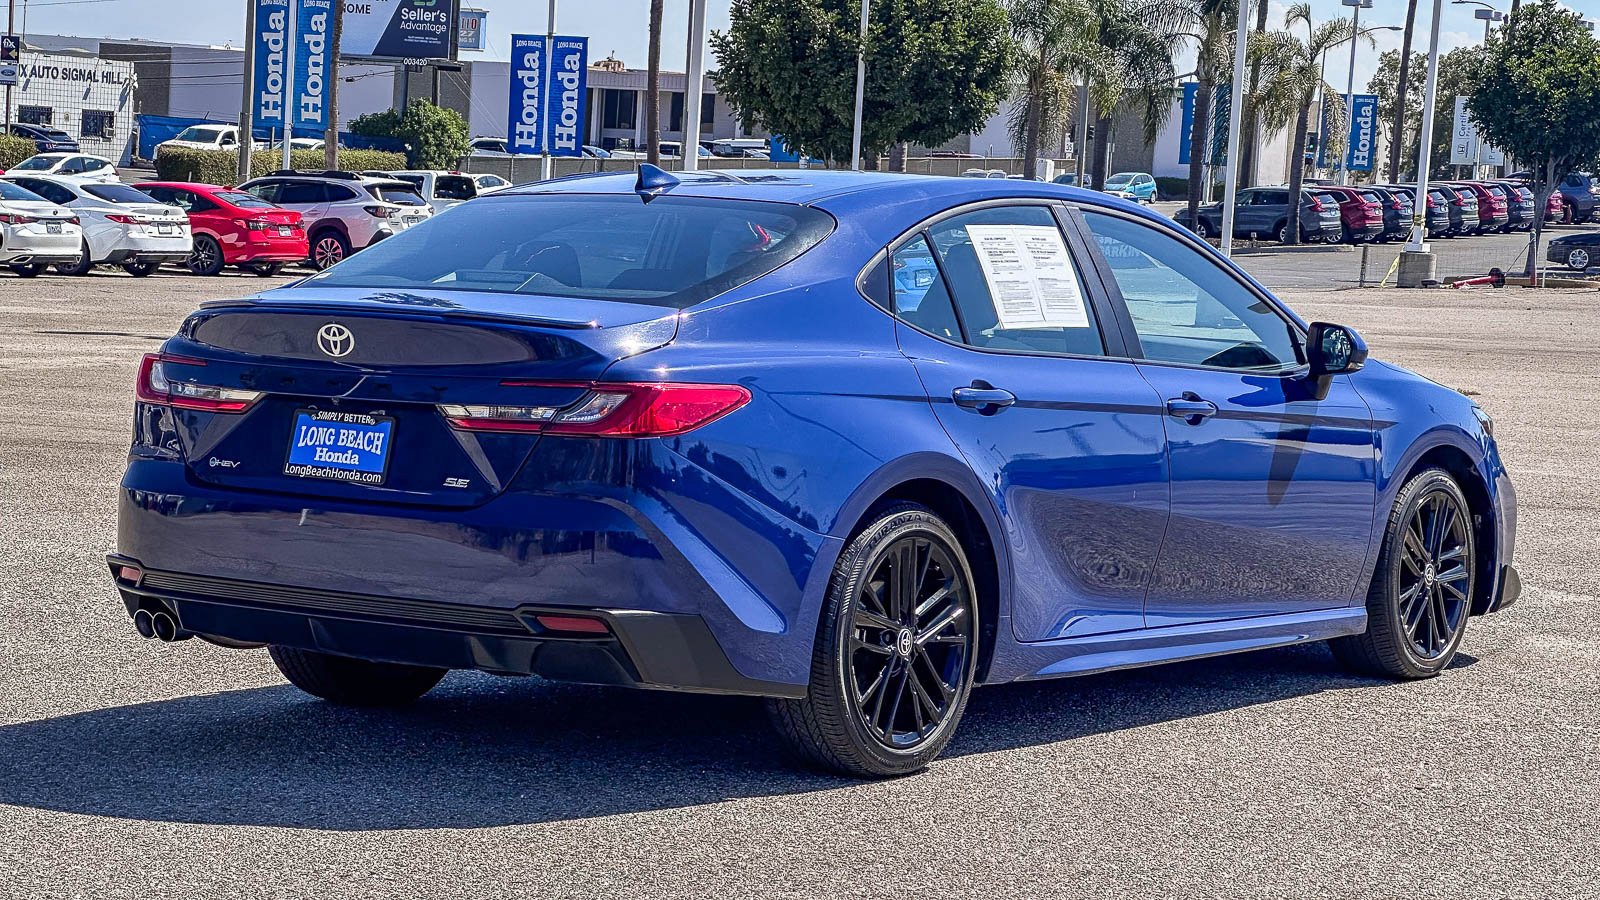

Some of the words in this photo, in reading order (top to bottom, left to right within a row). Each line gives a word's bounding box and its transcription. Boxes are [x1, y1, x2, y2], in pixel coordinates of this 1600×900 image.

[400, 20, 447, 34] Advantage
[29, 65, 59, 80] AUTO
[61, 67, 99, 82] SIGNAL
[101, 70, 123, 85] HILL
[261, 10, 285, 120] Honda
[301, 12, 327, 123] Honda
[515, 50, 540, 148] Honda
[555, 52, 581, 151] Honda
[1353, 104, 1373, 167] Honda
[316, 411, 344, 422] SIMPLY
[344, 413, 371, 424] BETTER
[298, 425, 336, 448] LONG
[337, 428, 385, 455] BEACH
[313, 447, 359, 465] Honda
[284, 462, 382, 483] LongBeachHonda.com
[442, 477, 470, 488] SE
[866, 514, 922, 551] TURANZA
